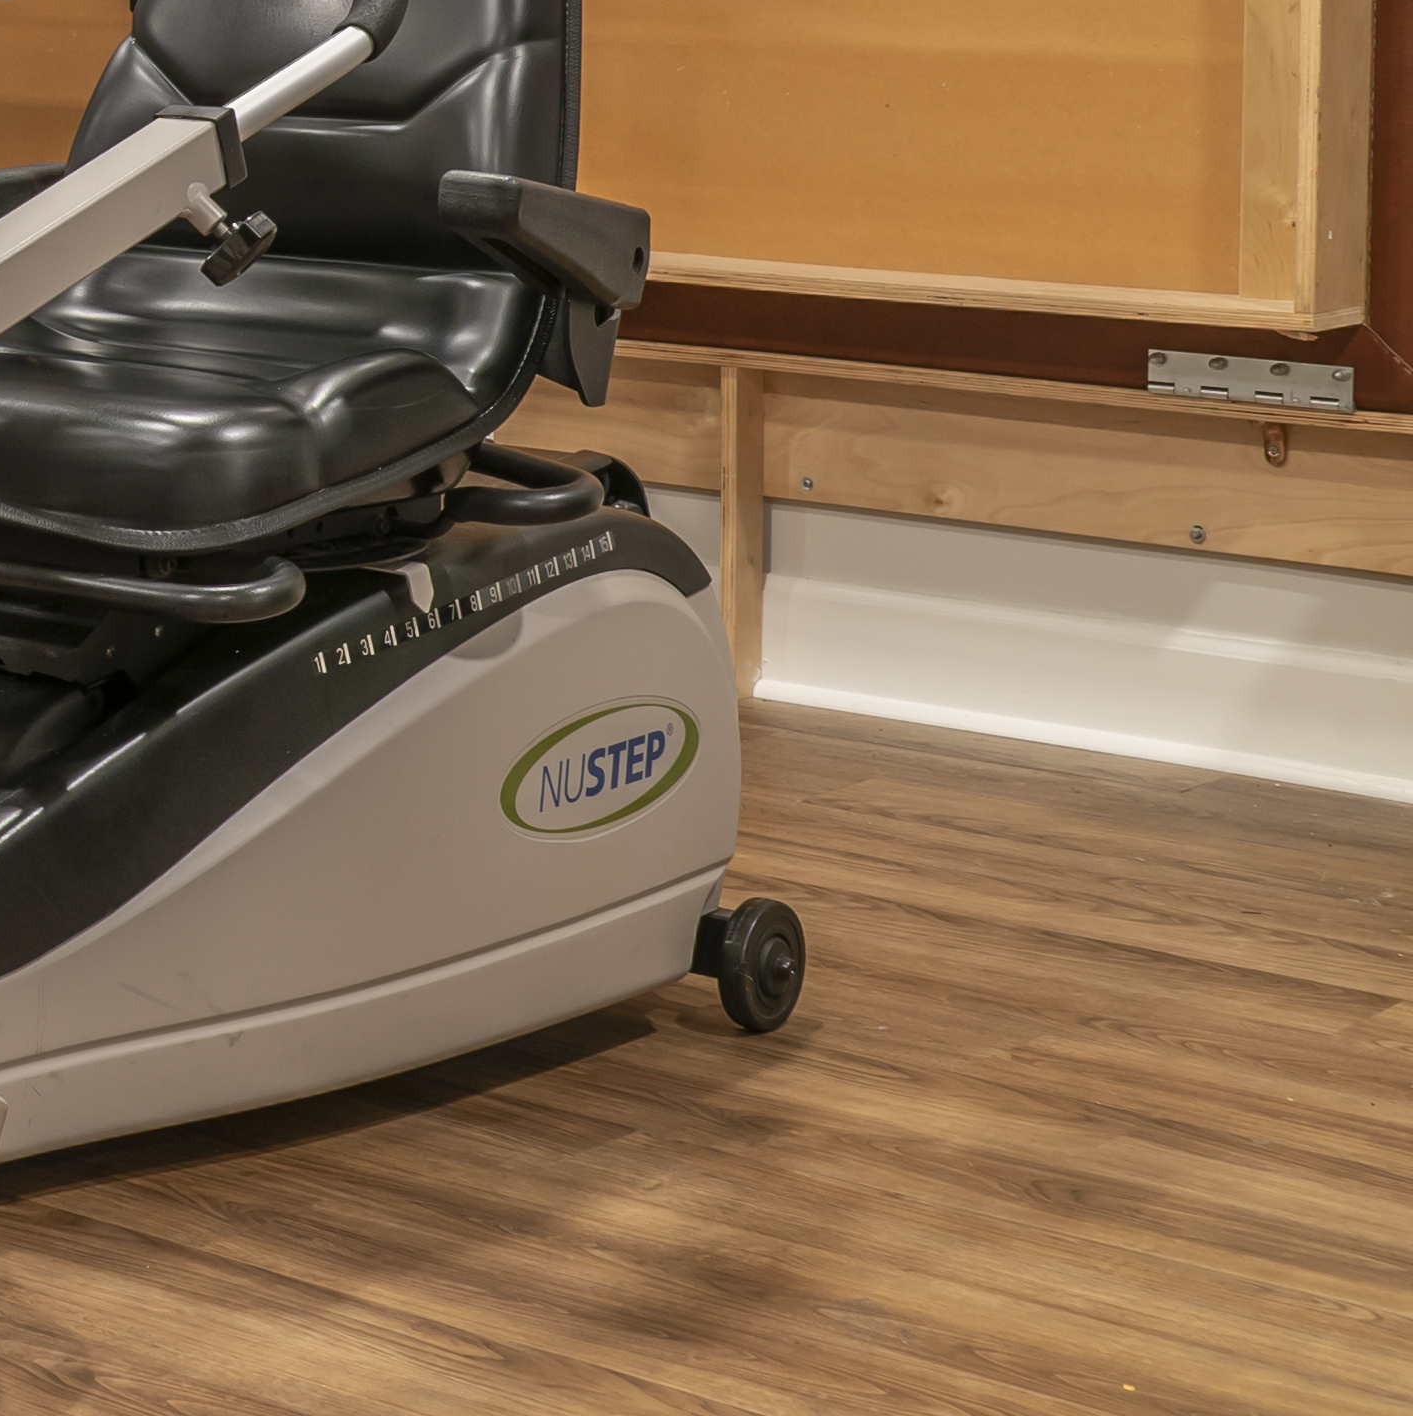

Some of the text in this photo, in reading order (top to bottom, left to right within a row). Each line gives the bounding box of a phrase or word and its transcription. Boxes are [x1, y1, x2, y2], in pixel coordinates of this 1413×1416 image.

[313, 536, 609, 673] 1 2 3 4 5 6 7 8 9 10 11 12 13 14 15
[539, 730, 666, 813] NUSTEP
